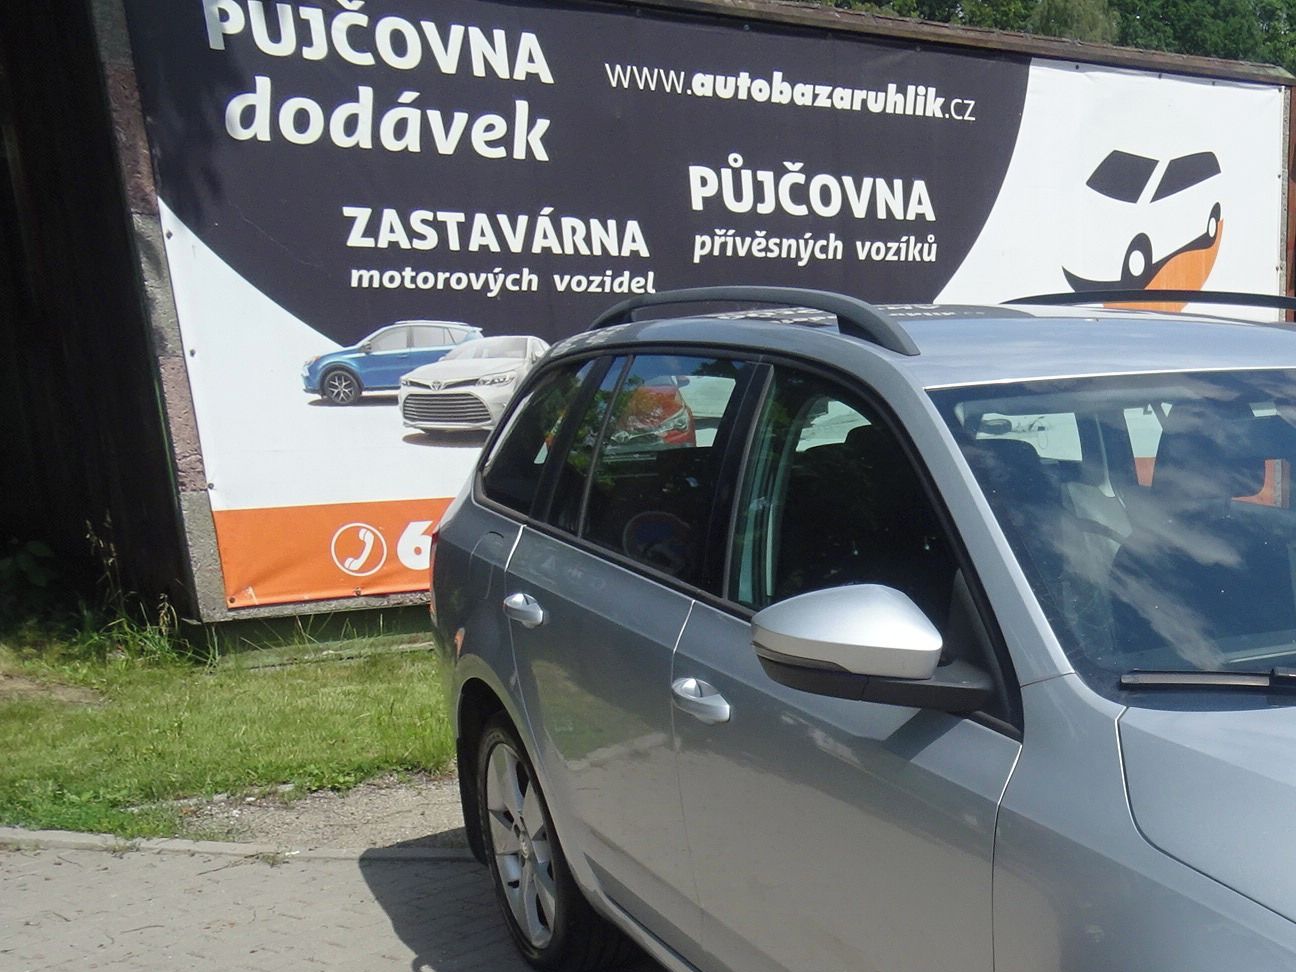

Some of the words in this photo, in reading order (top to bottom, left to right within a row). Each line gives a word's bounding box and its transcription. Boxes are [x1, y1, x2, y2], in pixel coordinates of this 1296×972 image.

[225, 76, 551, 161] dodávek
[605, 64, 976, 121] www.autobazaruhlik.cz
[689, 153, 937, 221] PŮJČOVNA
[342, 206, 650, 258] ZASTAVÁRNA
[693, 231, 843, 267] přívěsných
[856, 233, 938, 263] vozíků
[350, 267, 539, 298] motorových
[553, 270, 656, 295] vozidel
